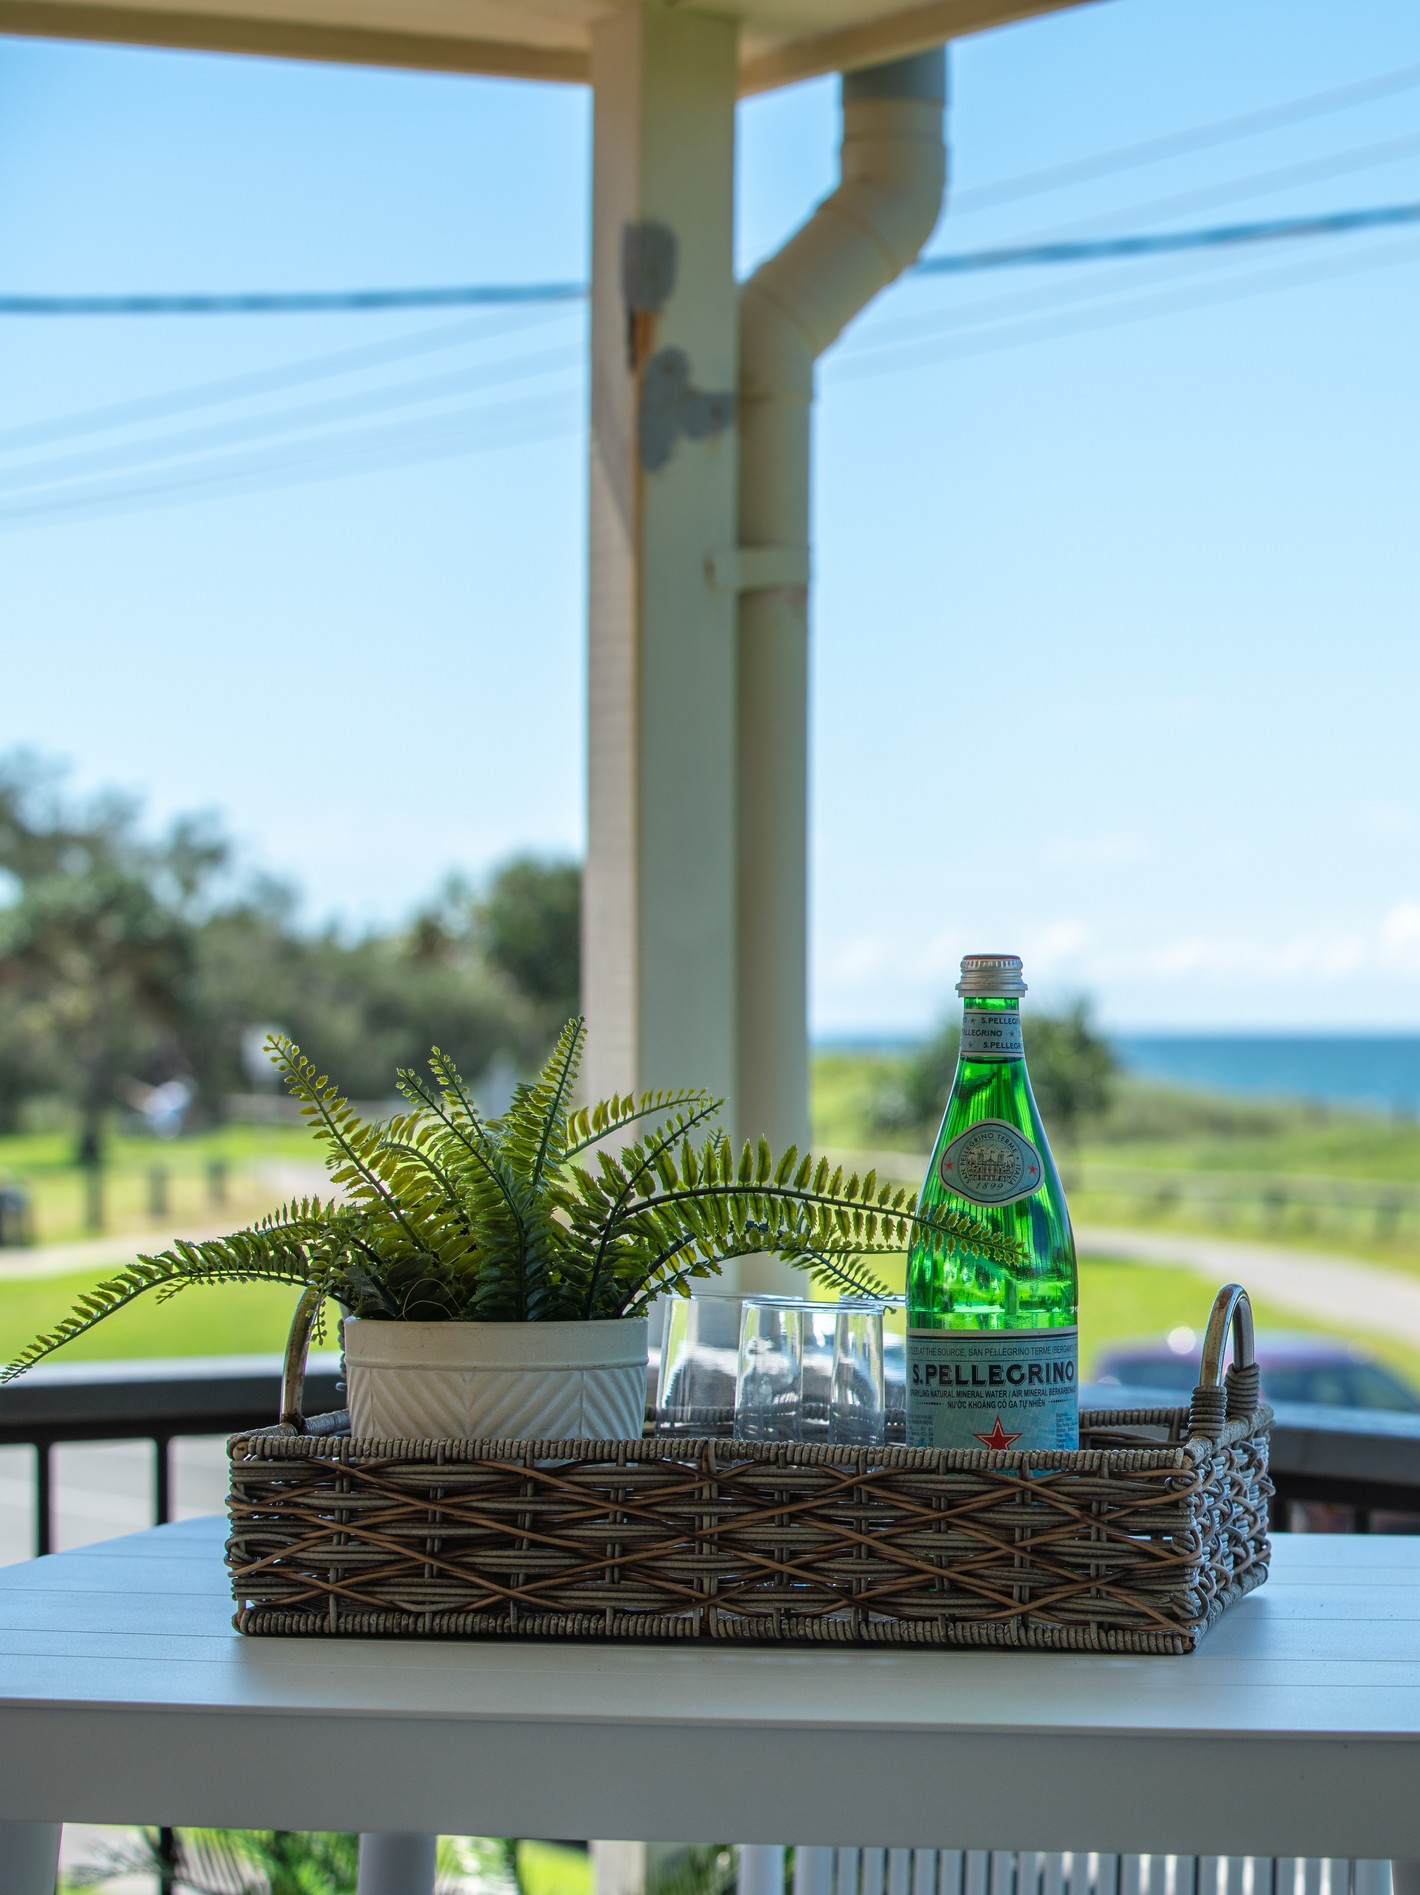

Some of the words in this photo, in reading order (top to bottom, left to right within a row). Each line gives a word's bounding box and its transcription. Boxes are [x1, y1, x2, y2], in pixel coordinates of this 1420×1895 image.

[960, 1132, 994, 1166] PELLEGRINO
[997, 1133, 1018, 1153] TERME
[961, 1169, 972, 1184] SAN
[1007, 1164, 1021, 1186] ITALIA
[975, 1181, 1004, 1190] 1899
[926, 1347, 936, 1356] THE
[938, 1347, 967, 1357] SOURCE,
[968, 1348, 983, 1357] SAN
[985, 1347, 1030, 1356] PELLEGRINO
[1031, 1346, 1052, 1355] TERME
[912, 1361, 1074, 1387] S.PELLEGRINO
[930, 1389, 955, 1398] NATURAL
[956, 1390, 983, 1399] MINERAL
[985, 1390, 1008, 1398] WATER
[1012, 1389, 1022, 1398] AIR
[1024, 1388, 1048, 1397] MINERAL
[1008, 1400, 1018, 1409] GA
